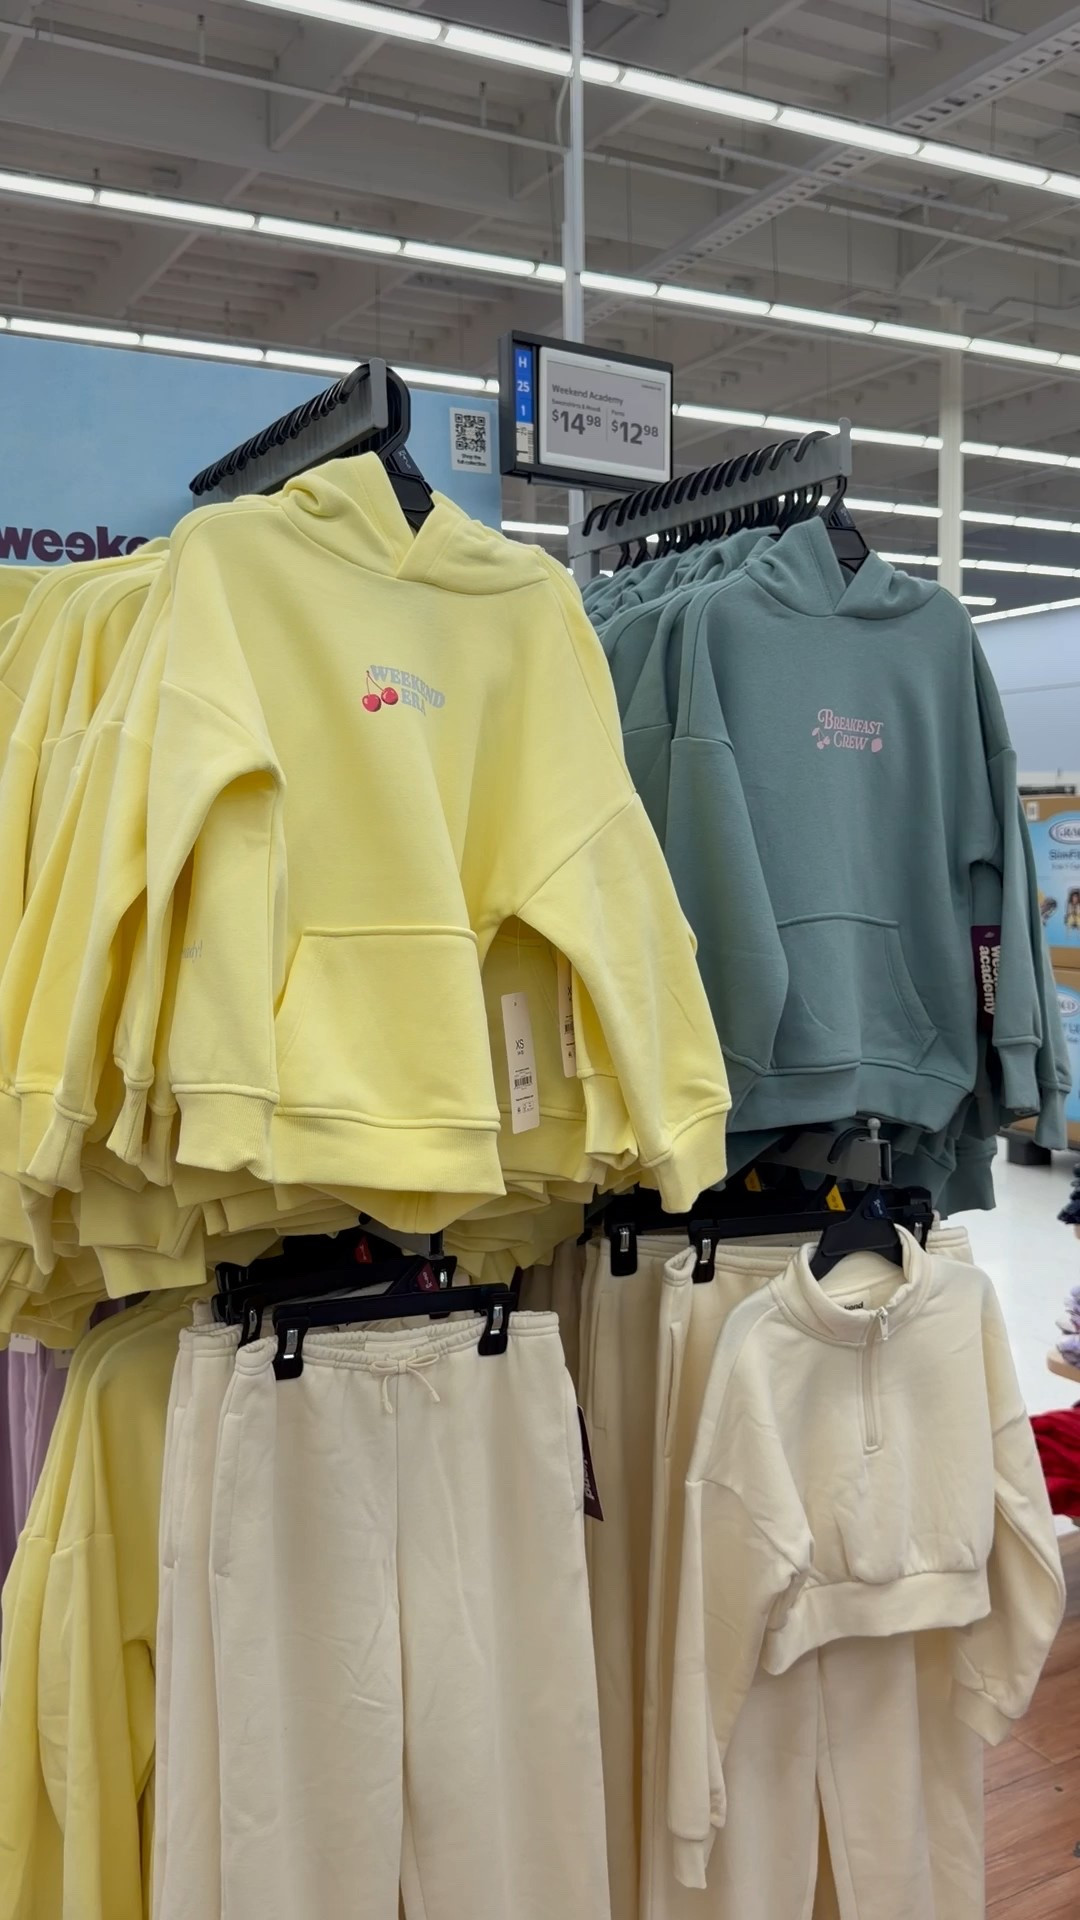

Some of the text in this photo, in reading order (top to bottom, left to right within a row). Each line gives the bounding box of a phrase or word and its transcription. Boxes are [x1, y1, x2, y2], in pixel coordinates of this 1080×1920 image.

[518, 355, 528, 368] H
[517, 380, 530, 393] 25
[552, 383, 624, 406] Weekend Academy
[520, 404, 526, 416] 1
[370, 664, 445, 708] WEEKEND
[817, 708, 884, 735] BREAKFAST
[833, 730, 869, 750] CREW
[979, 945, 996, 1015] academy
[515, 1038, 525, 1051] XS
